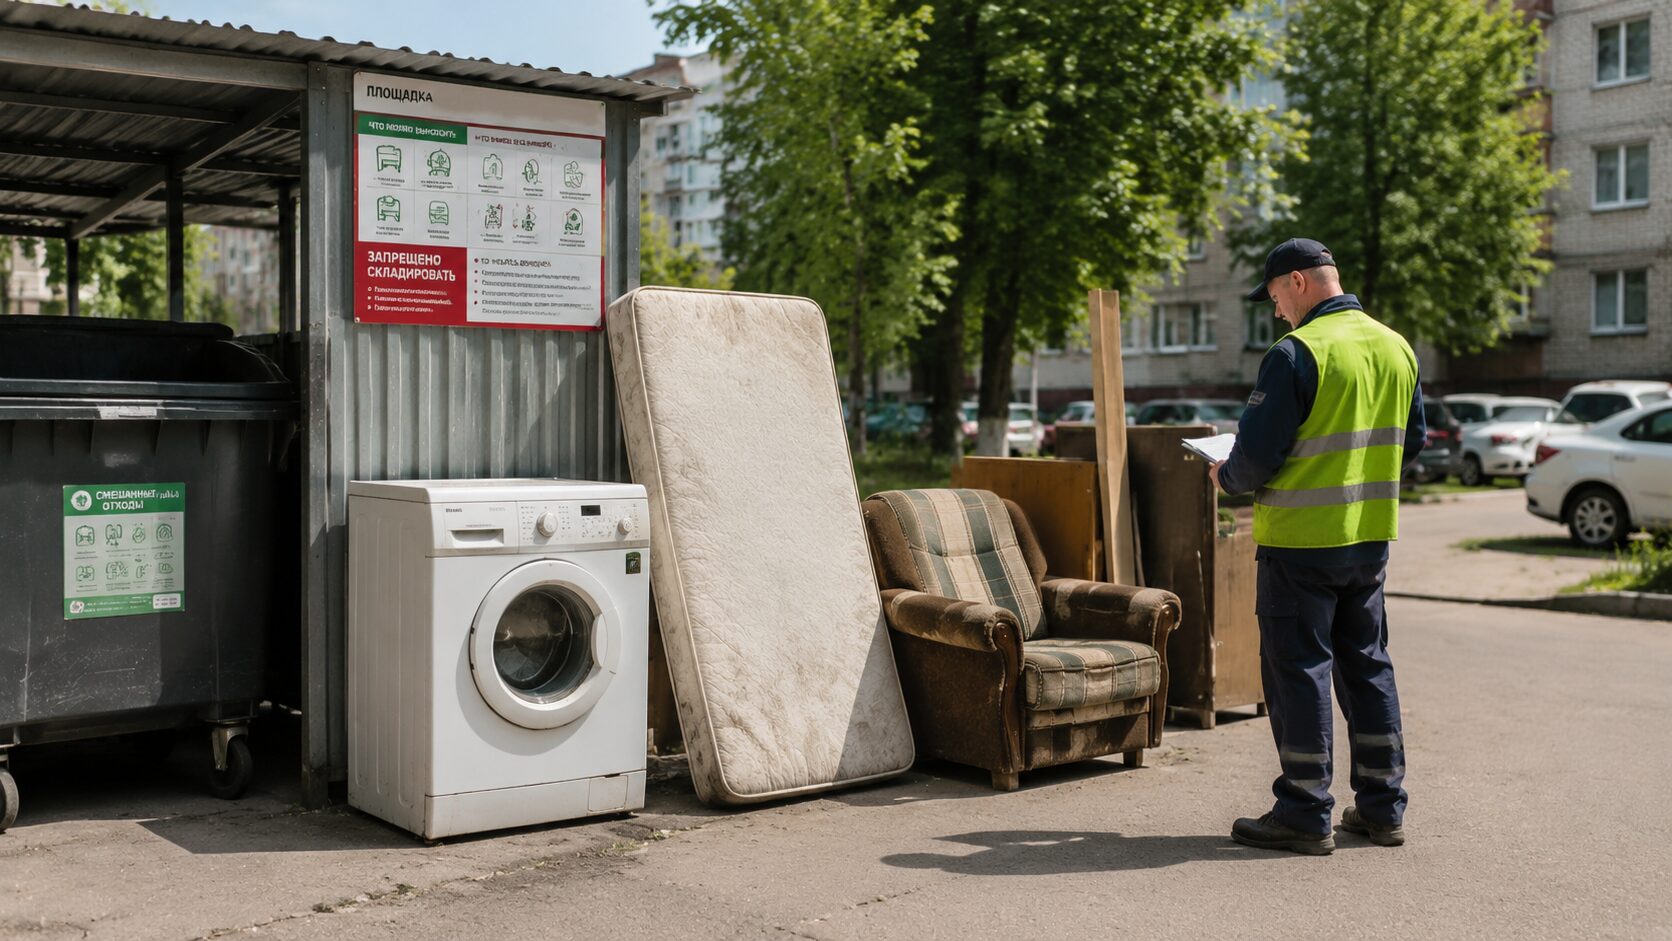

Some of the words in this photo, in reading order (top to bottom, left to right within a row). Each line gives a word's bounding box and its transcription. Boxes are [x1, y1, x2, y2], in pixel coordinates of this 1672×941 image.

[367, 85, 433, 103] ПЛОЩАДКА
[367, 251, 441, 265] ЗАПРЕЩЕНО
[367, 266, 456, 282] СКЛАДИРОВАТЬ
[102, 501, 144, 511] ОТХОДЫ
